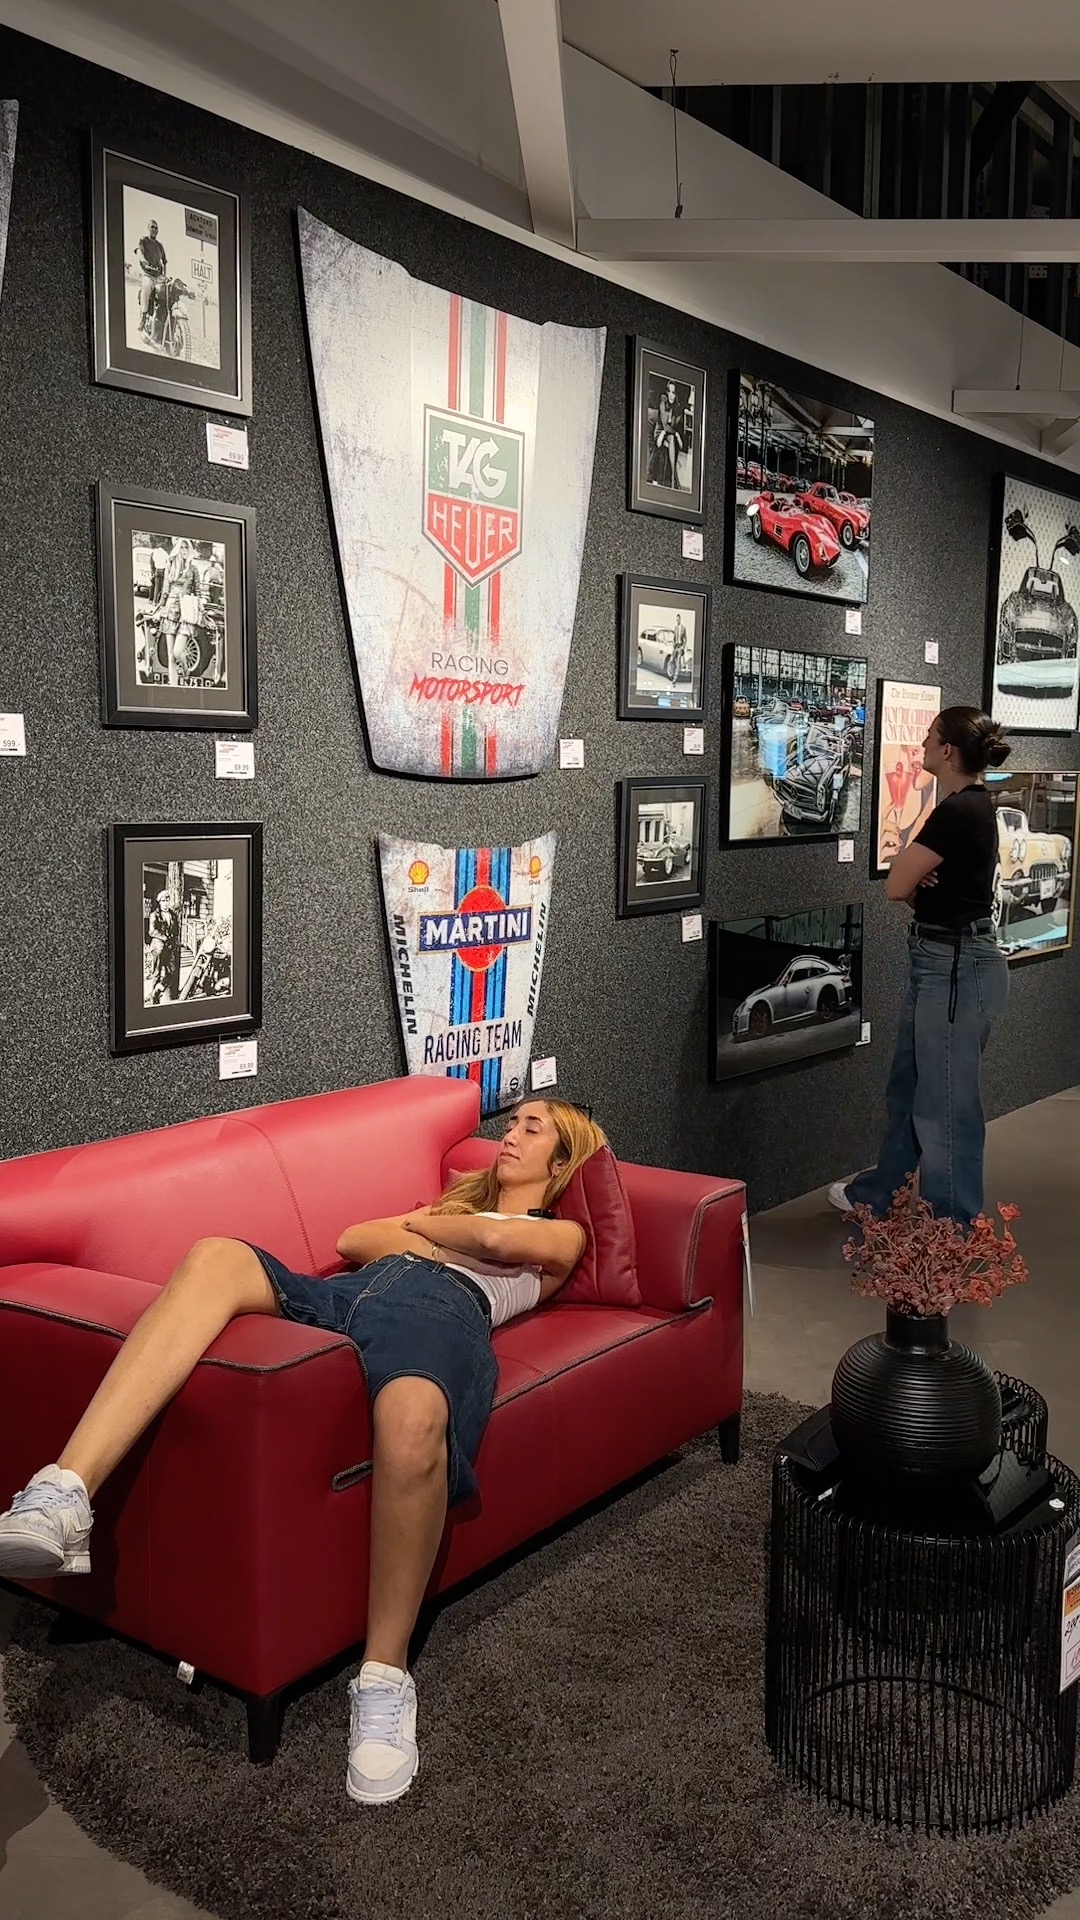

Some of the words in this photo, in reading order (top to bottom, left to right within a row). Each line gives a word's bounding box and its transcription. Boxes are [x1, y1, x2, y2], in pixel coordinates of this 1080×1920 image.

[193, 262, 211, 281] HALT
[442, 429, 508, 499] TAG
[432, 500, 514, 570] HEUER
[431, 652, 509, 676] RACING
[408, 671, 527, 706] MOTORSPORT
[425, 911, 528, 946] MARTINI
[393, 914, 418, 1035] MICHELIN
[527, 901, 547, 1018] MICHELIN
[424, 1027, 481, 1065] RACING
[486, 1019, 522, 1053] TEAM
